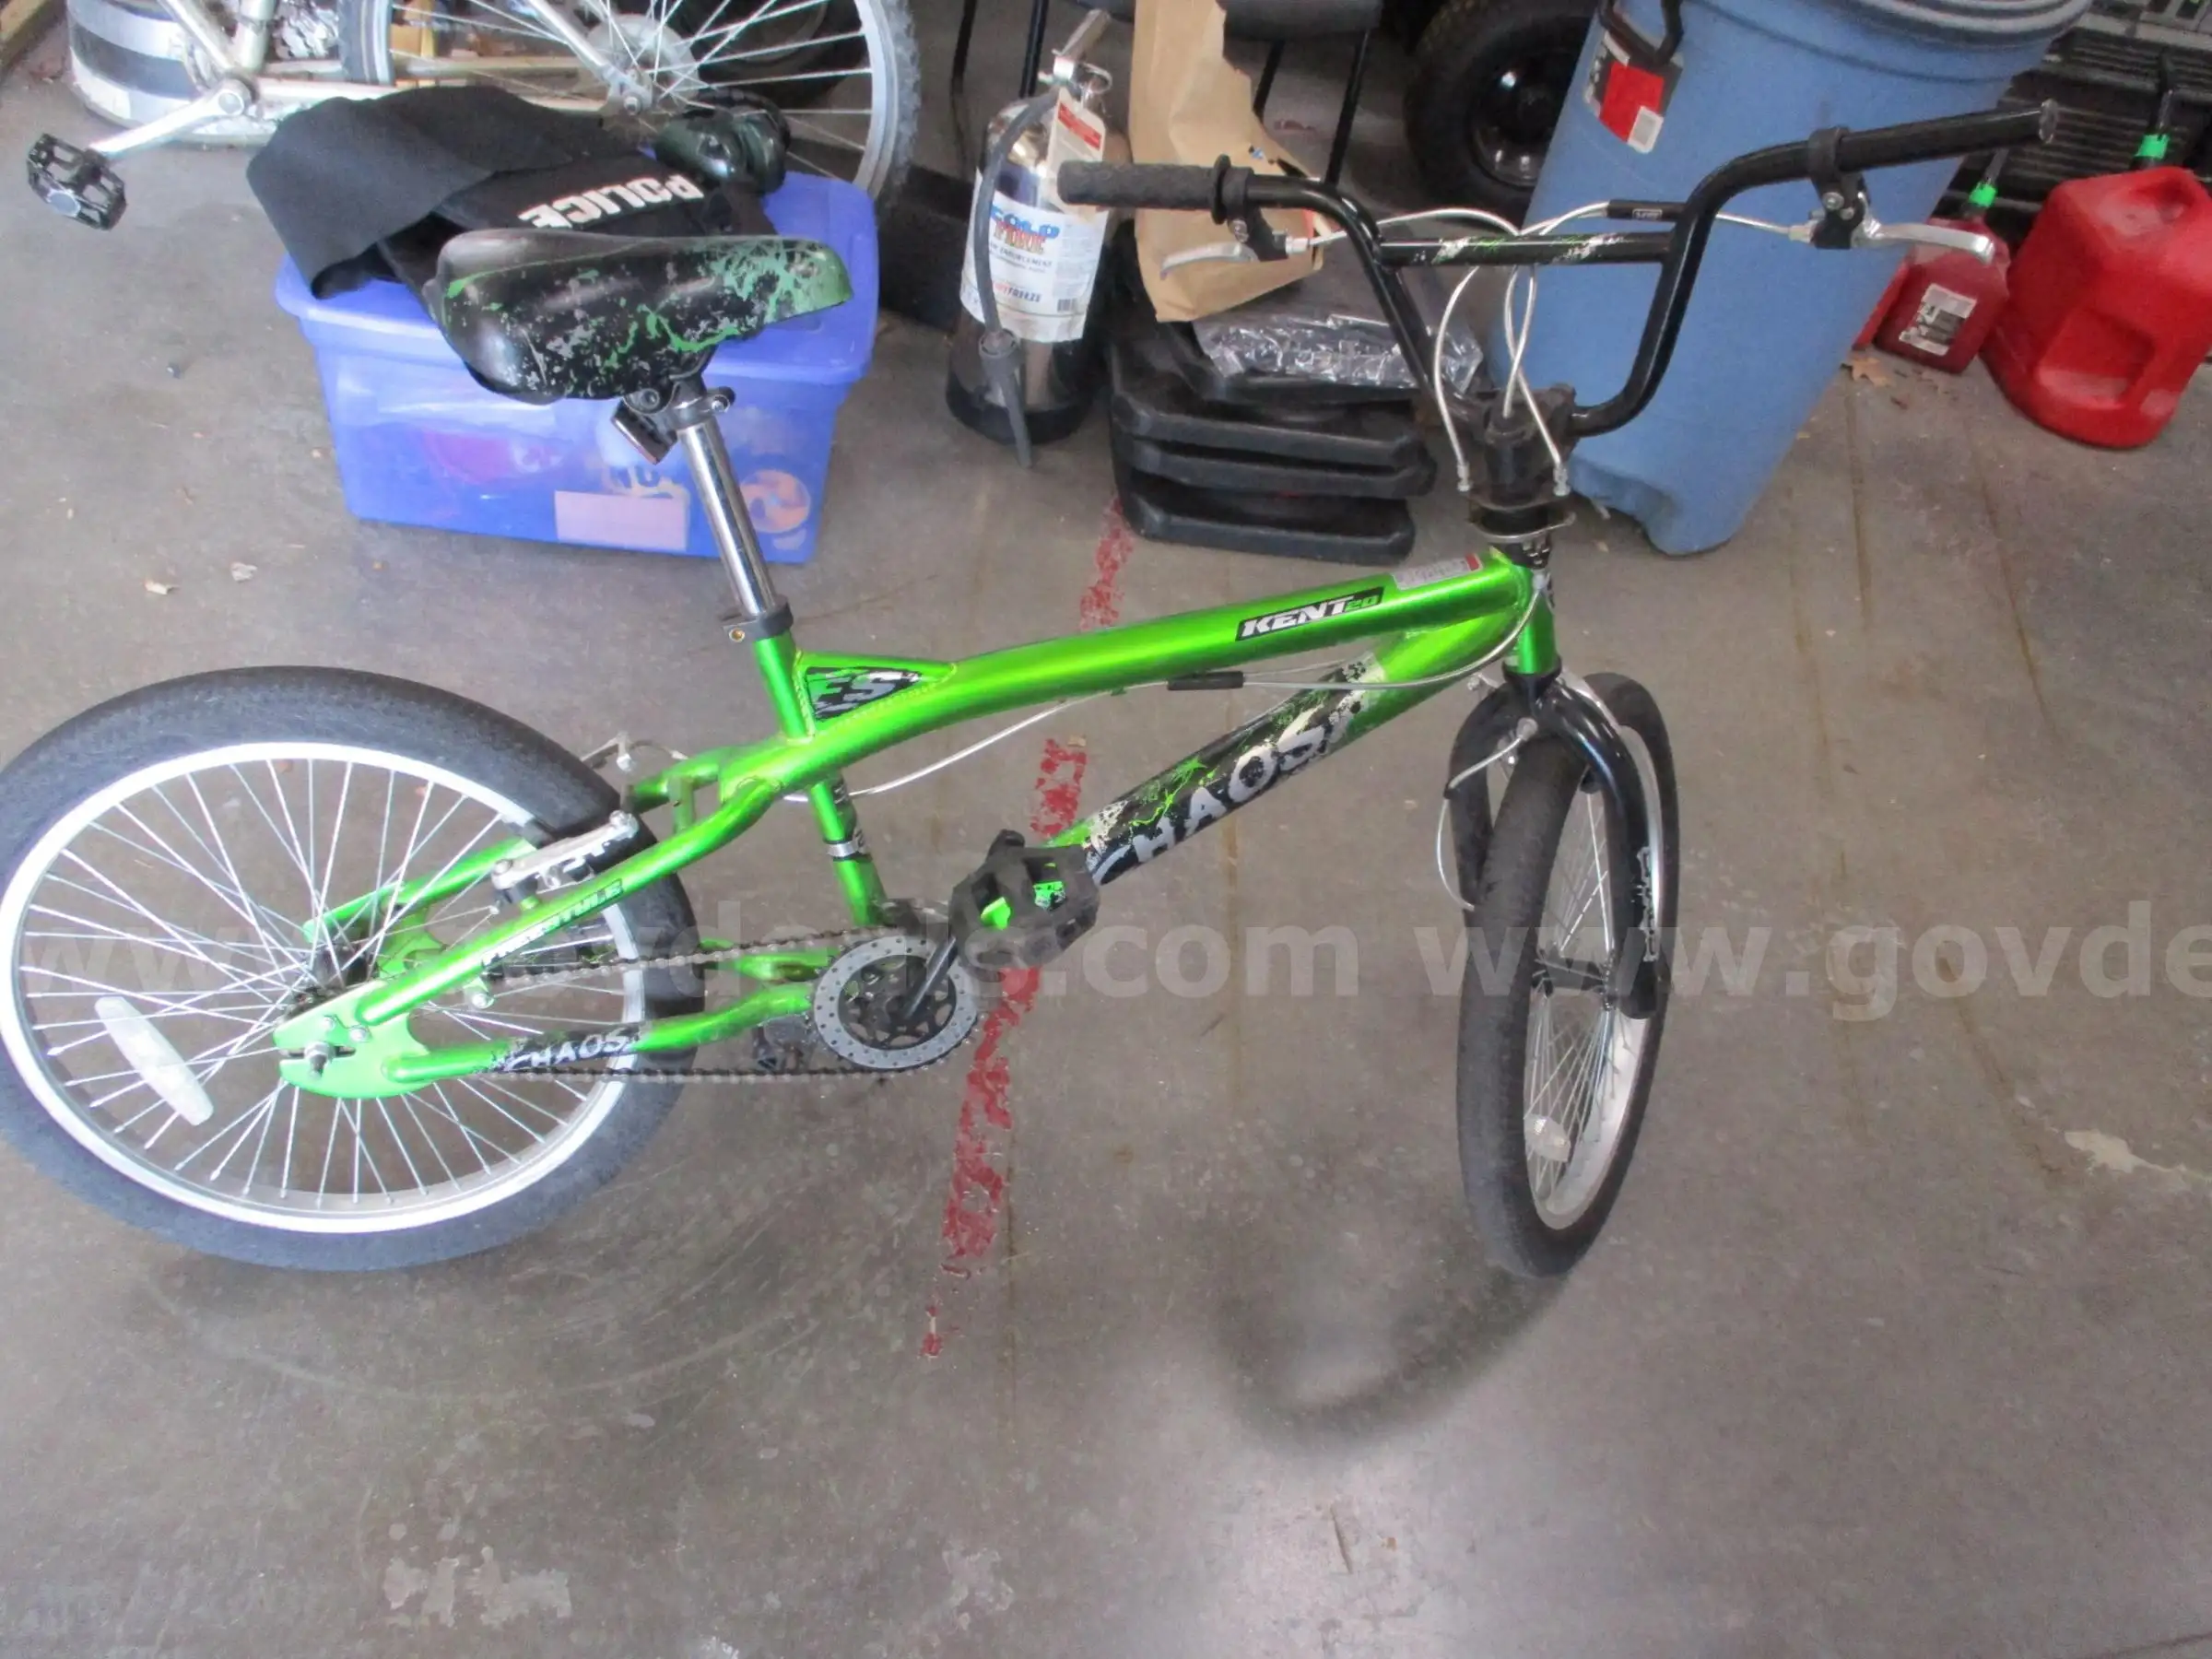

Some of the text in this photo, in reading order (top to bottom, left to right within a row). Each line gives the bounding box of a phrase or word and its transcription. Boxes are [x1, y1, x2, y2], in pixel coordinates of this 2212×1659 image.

[518, 174, 704, 228] POLICE
[1092, 703, 1327, 885] CHAOS
[503, 1028, 629, 1071] CHAOS
